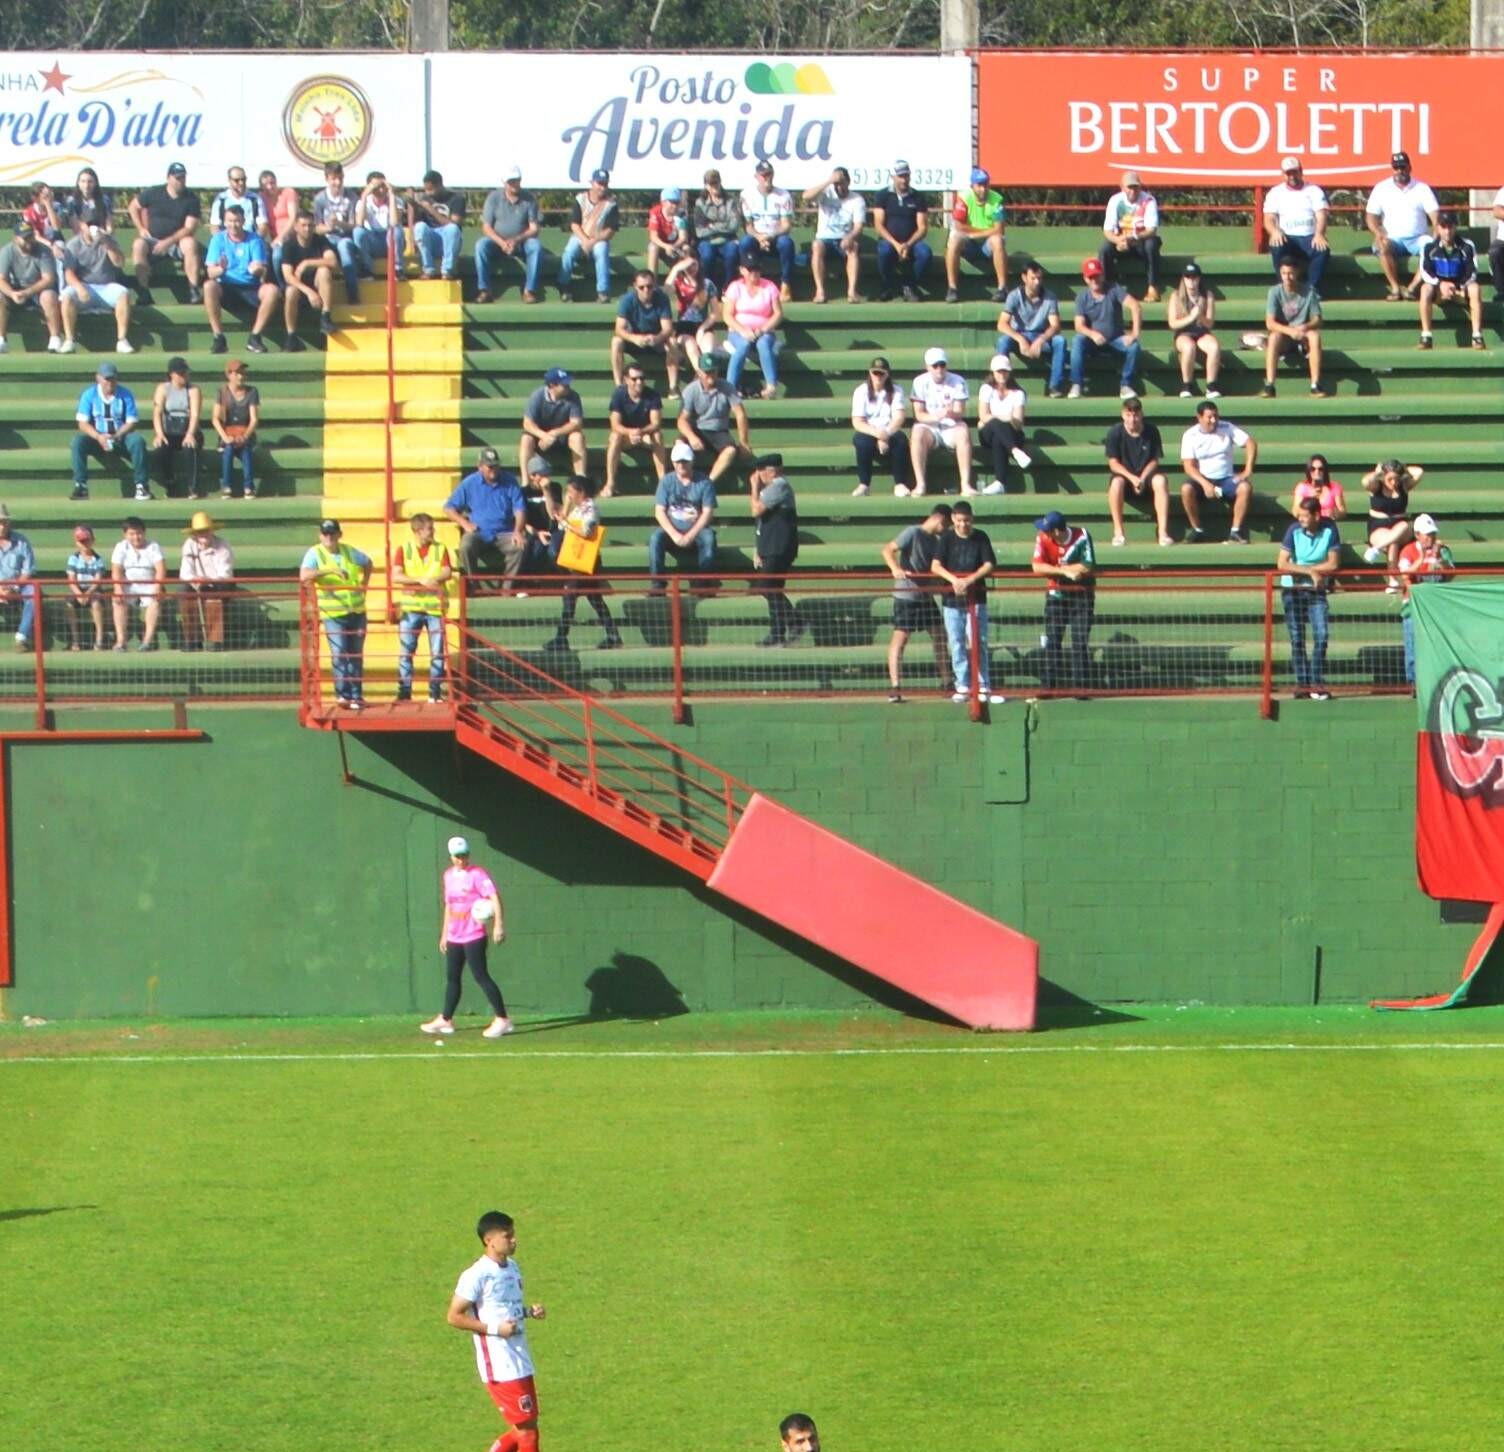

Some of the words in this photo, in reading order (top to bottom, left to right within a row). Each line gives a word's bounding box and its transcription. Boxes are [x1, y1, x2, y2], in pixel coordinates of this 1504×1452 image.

[629, 63, 739, 106] Posto
[1163, 68, 1338, 92] SUPER
[78, 96, 205, 149] D'alva
[561, 95, 836, 184] Avenida
[1067, 100, 1431, 156] BERTOLETTI
